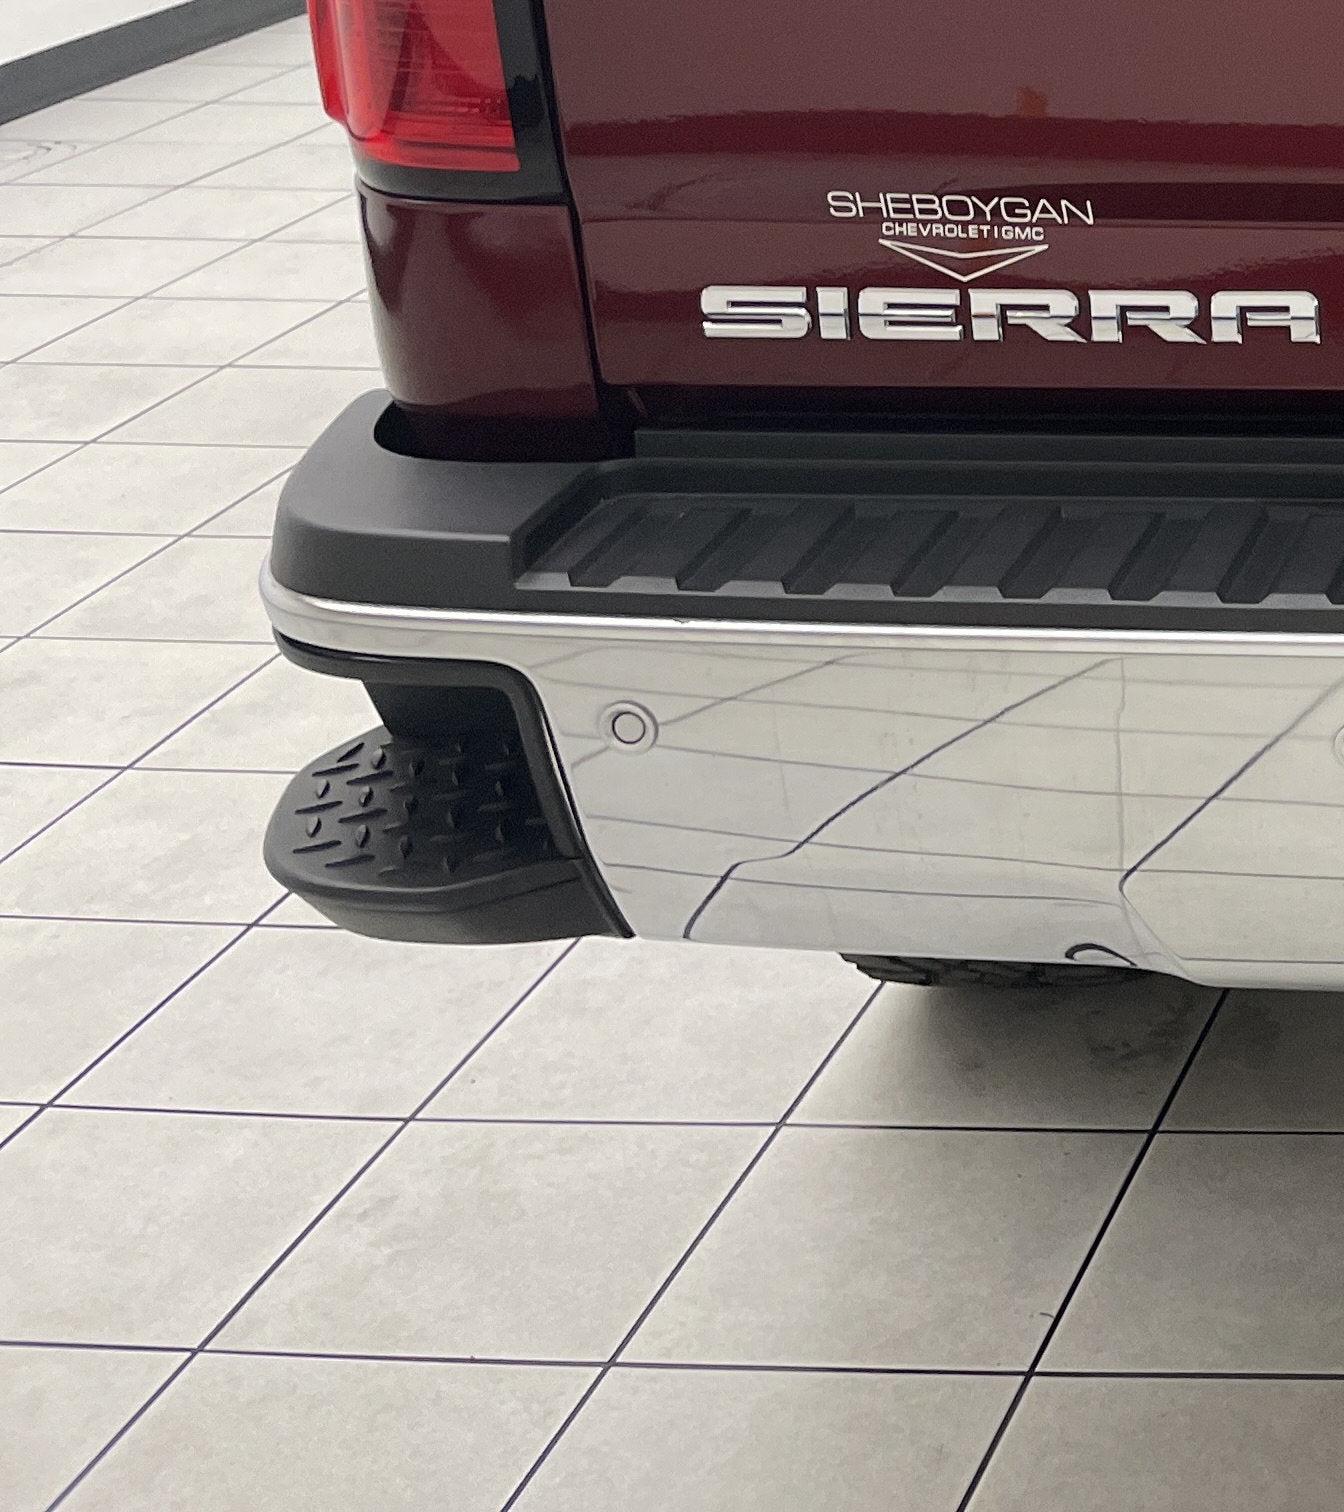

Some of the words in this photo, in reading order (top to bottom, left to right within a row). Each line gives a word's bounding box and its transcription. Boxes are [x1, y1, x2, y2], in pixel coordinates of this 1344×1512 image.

[827, 190, 1094, 225] SHEBOYGAN
[881, 222, 992, 239] CHEVROLET
[1001, 226, 1045, 240] GMC
[700, 285, 1321, 345] SIERRA
